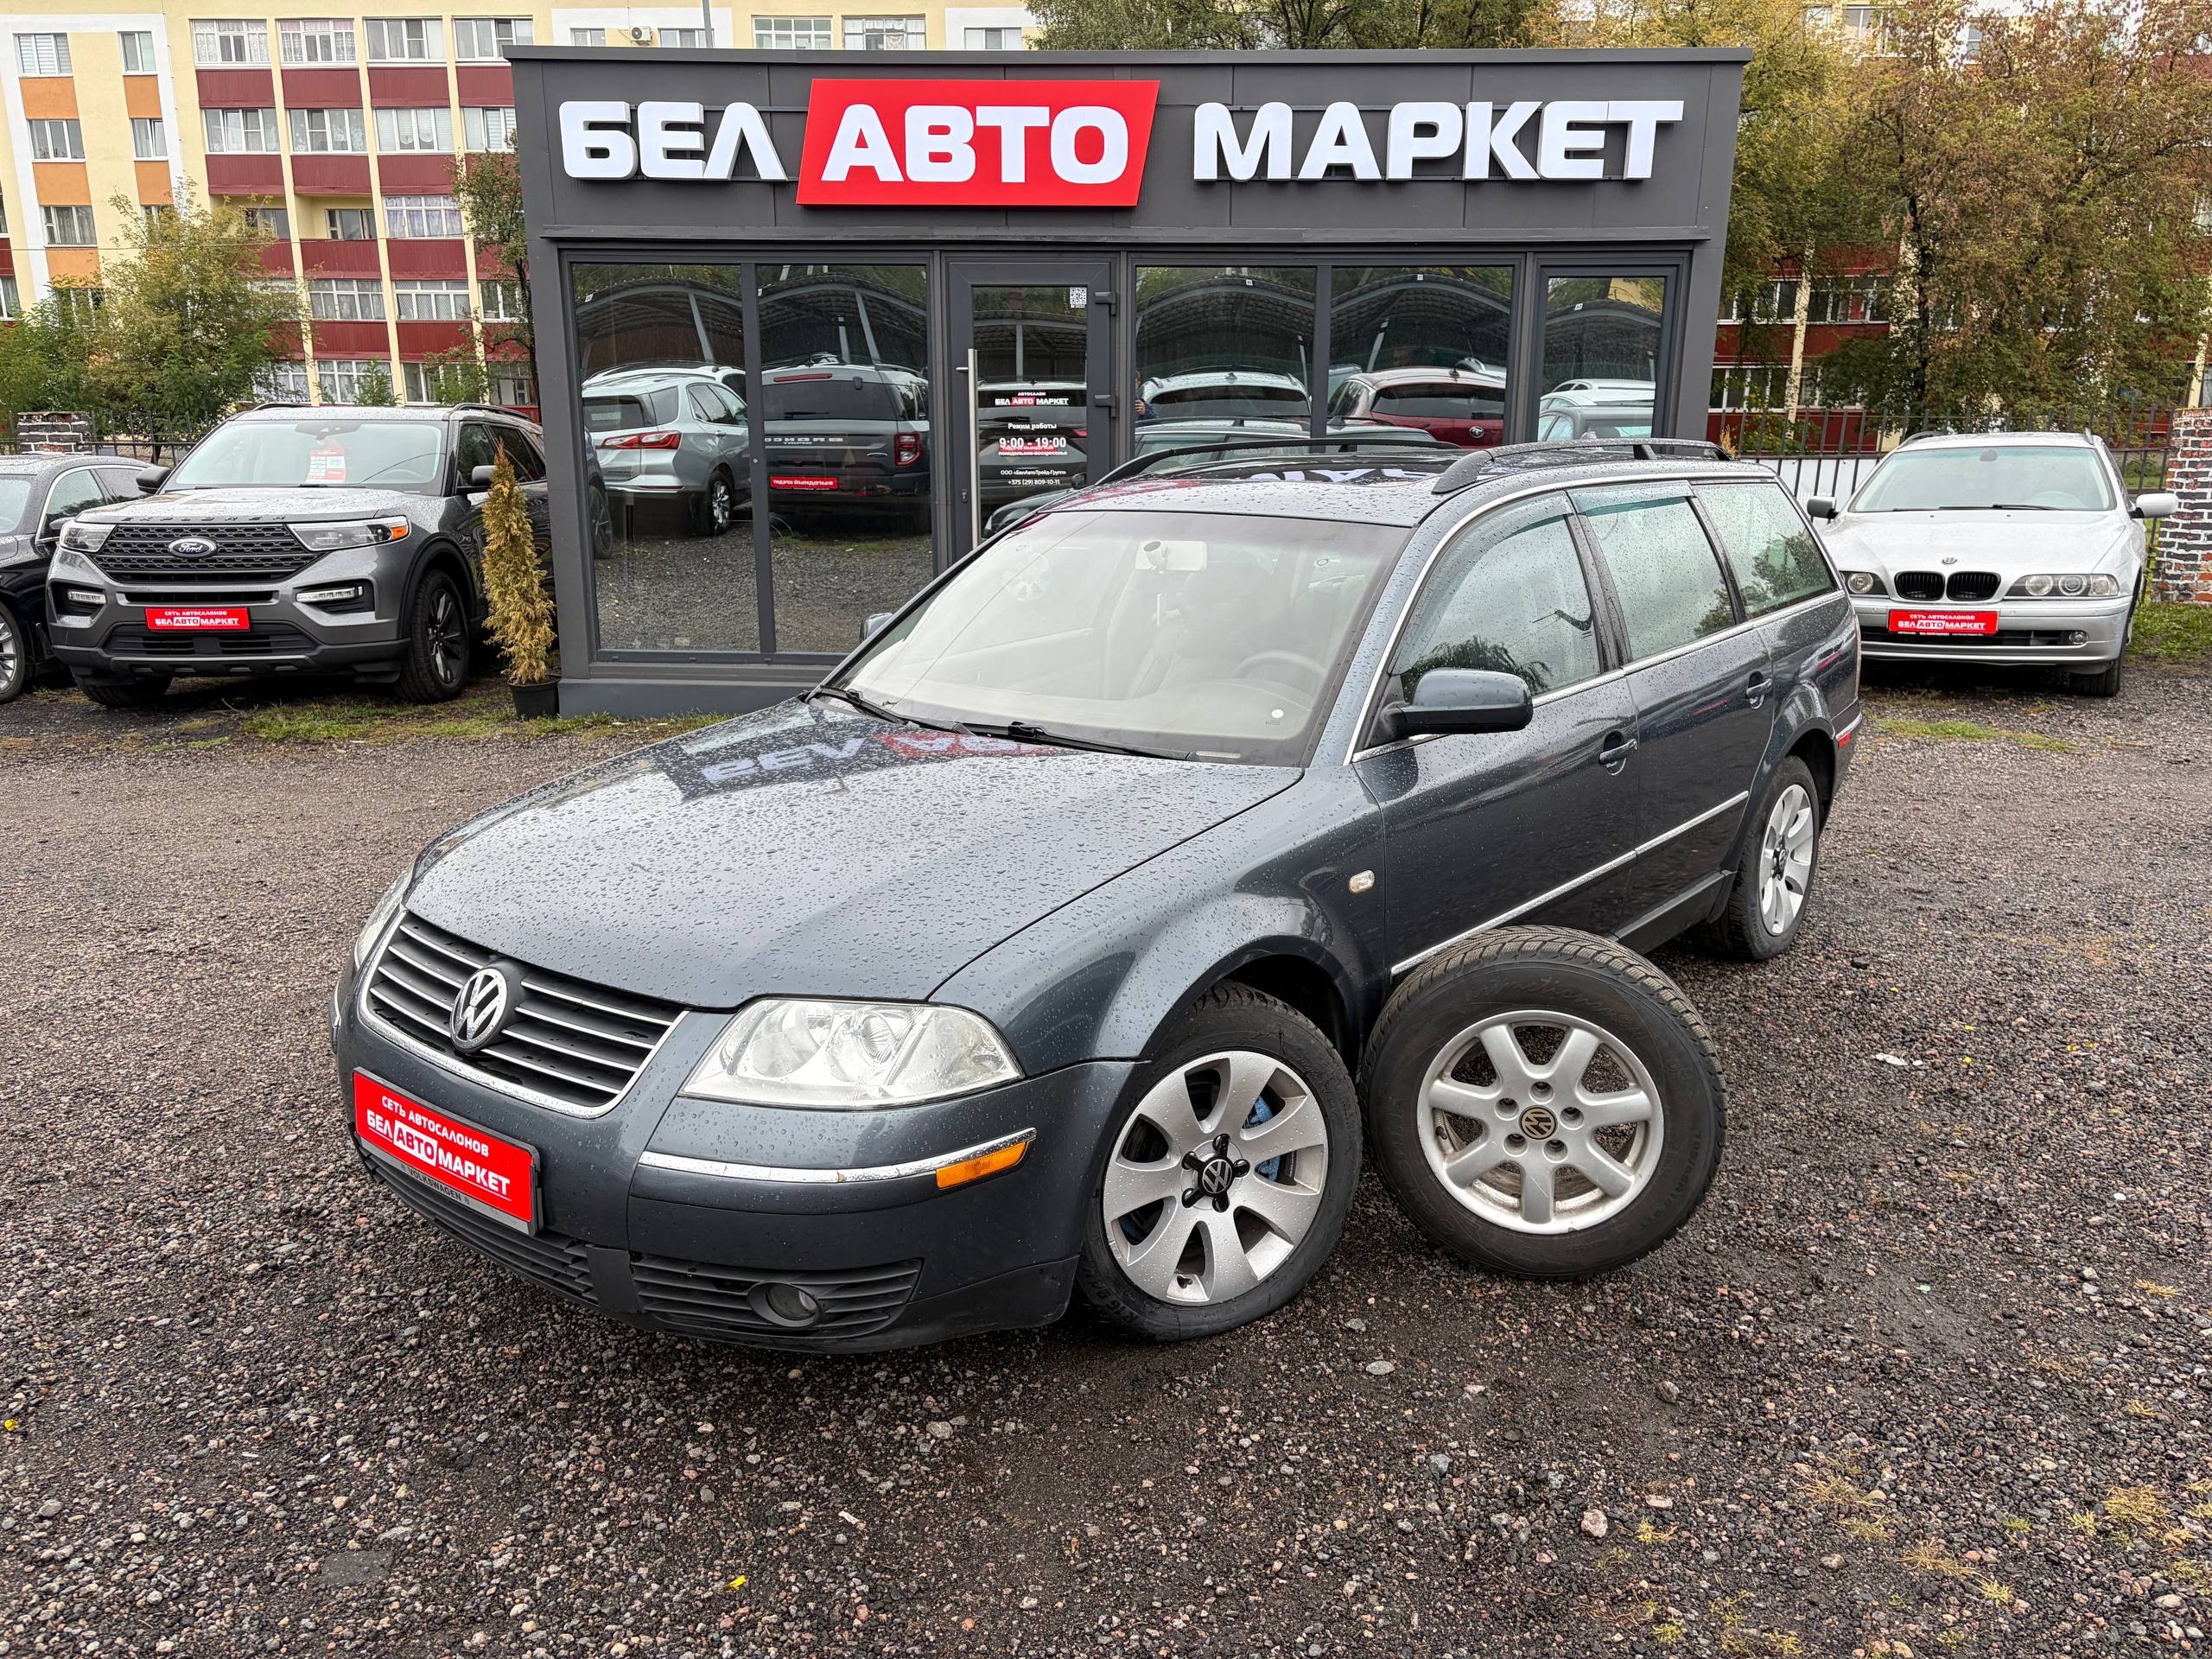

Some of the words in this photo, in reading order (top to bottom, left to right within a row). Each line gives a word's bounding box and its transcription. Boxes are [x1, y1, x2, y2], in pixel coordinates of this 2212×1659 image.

[559, 100, 788, 181] БЕЛ
[821, 103, 1128, 184] АВТО
[1193, 100, 1685, 181] МАРКЕТ
[999, 437, 1024, 448] 9:00
[1035, 437, 1066, 448] 19:00
[1032, 423, 1057, 431] работы
[179, 543, 203, 552] Ford
[381, 1095, 406, 1118] СЕТЬ
[408, 1111, 489, 1157] АВТОСАЛОНОВ
[366, 1108, 393, 1141] БЕЛ
[396, 1128, 435, 1160] АВТО
[438, 1147, 511, 1196] МАРКЕТ
[408, 1166, 462, 1203] VOLKSWAGEN
